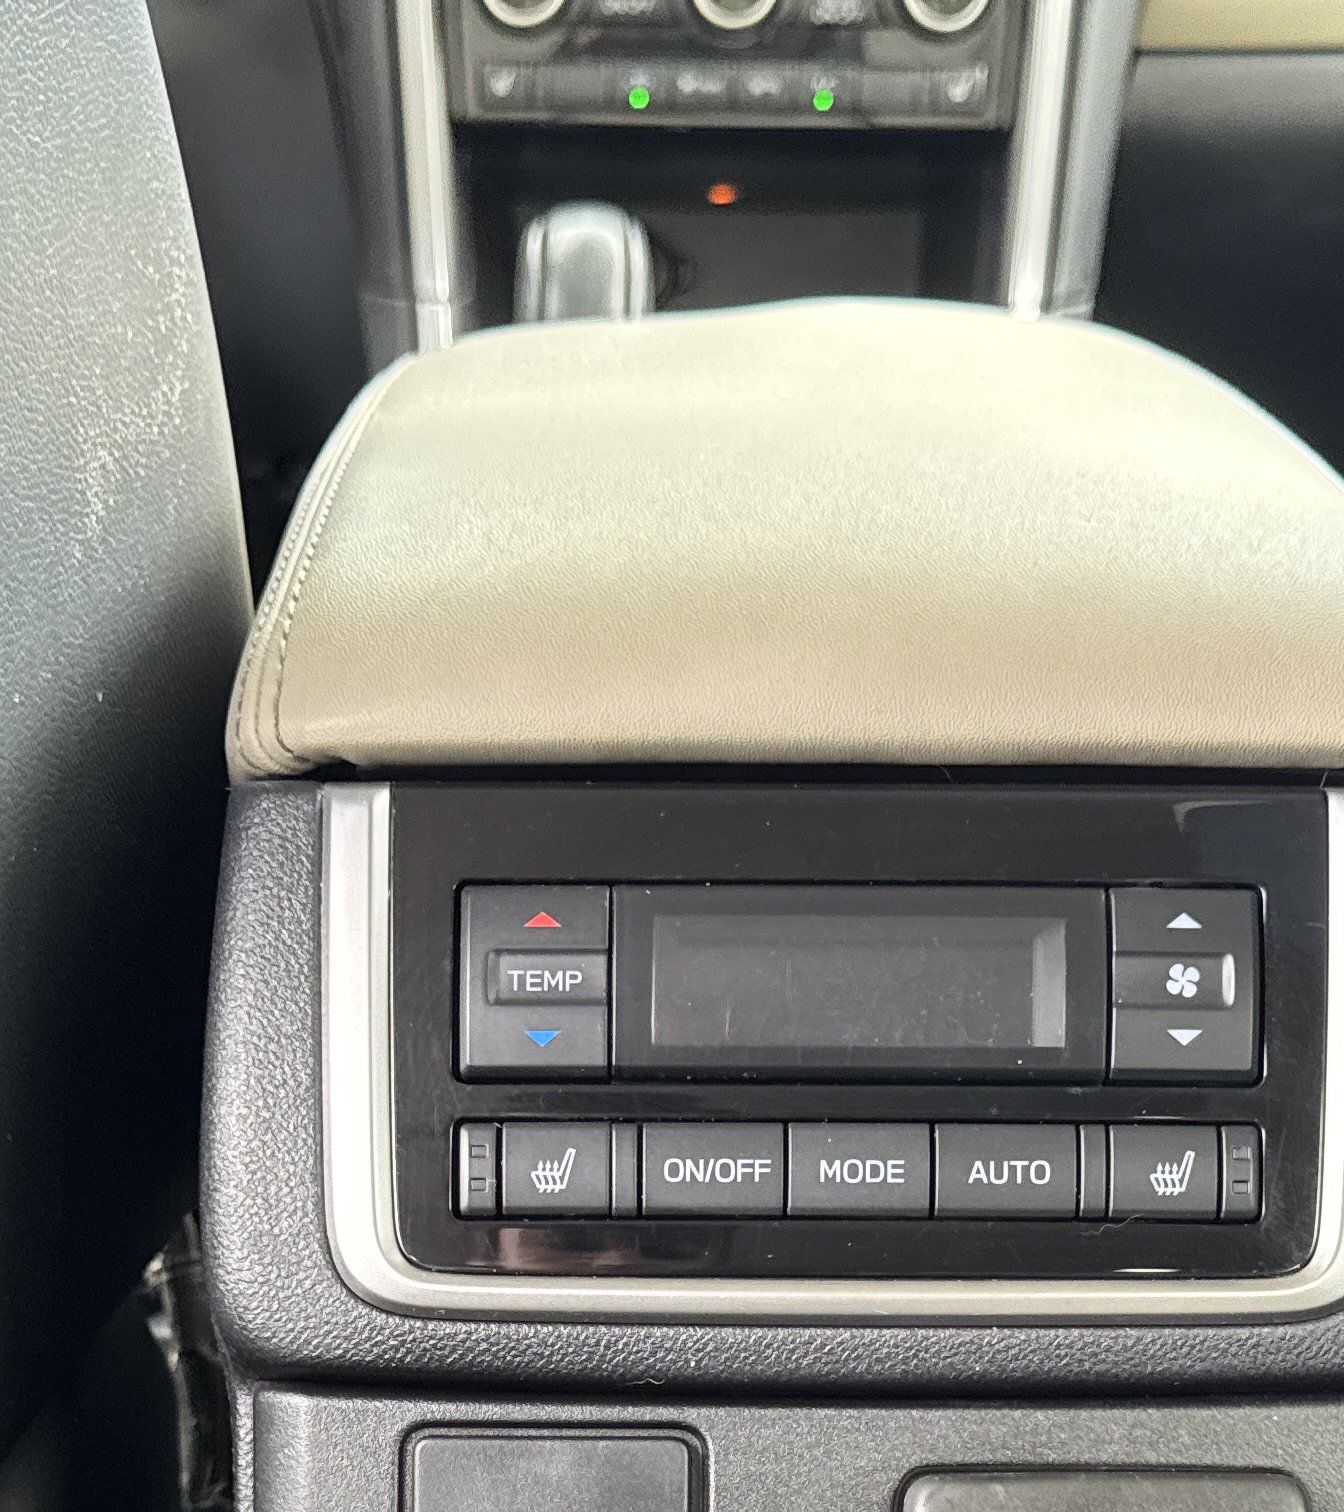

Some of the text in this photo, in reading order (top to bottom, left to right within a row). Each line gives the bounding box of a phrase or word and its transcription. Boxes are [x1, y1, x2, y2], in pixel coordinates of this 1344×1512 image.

[506, 968, 583, 992] TEMP
[663, 1157, 772, 1183] ON/OFF
[819, 1158, 905, 1184] MODE
[967, 1159, 1051, 1185] AUTO
